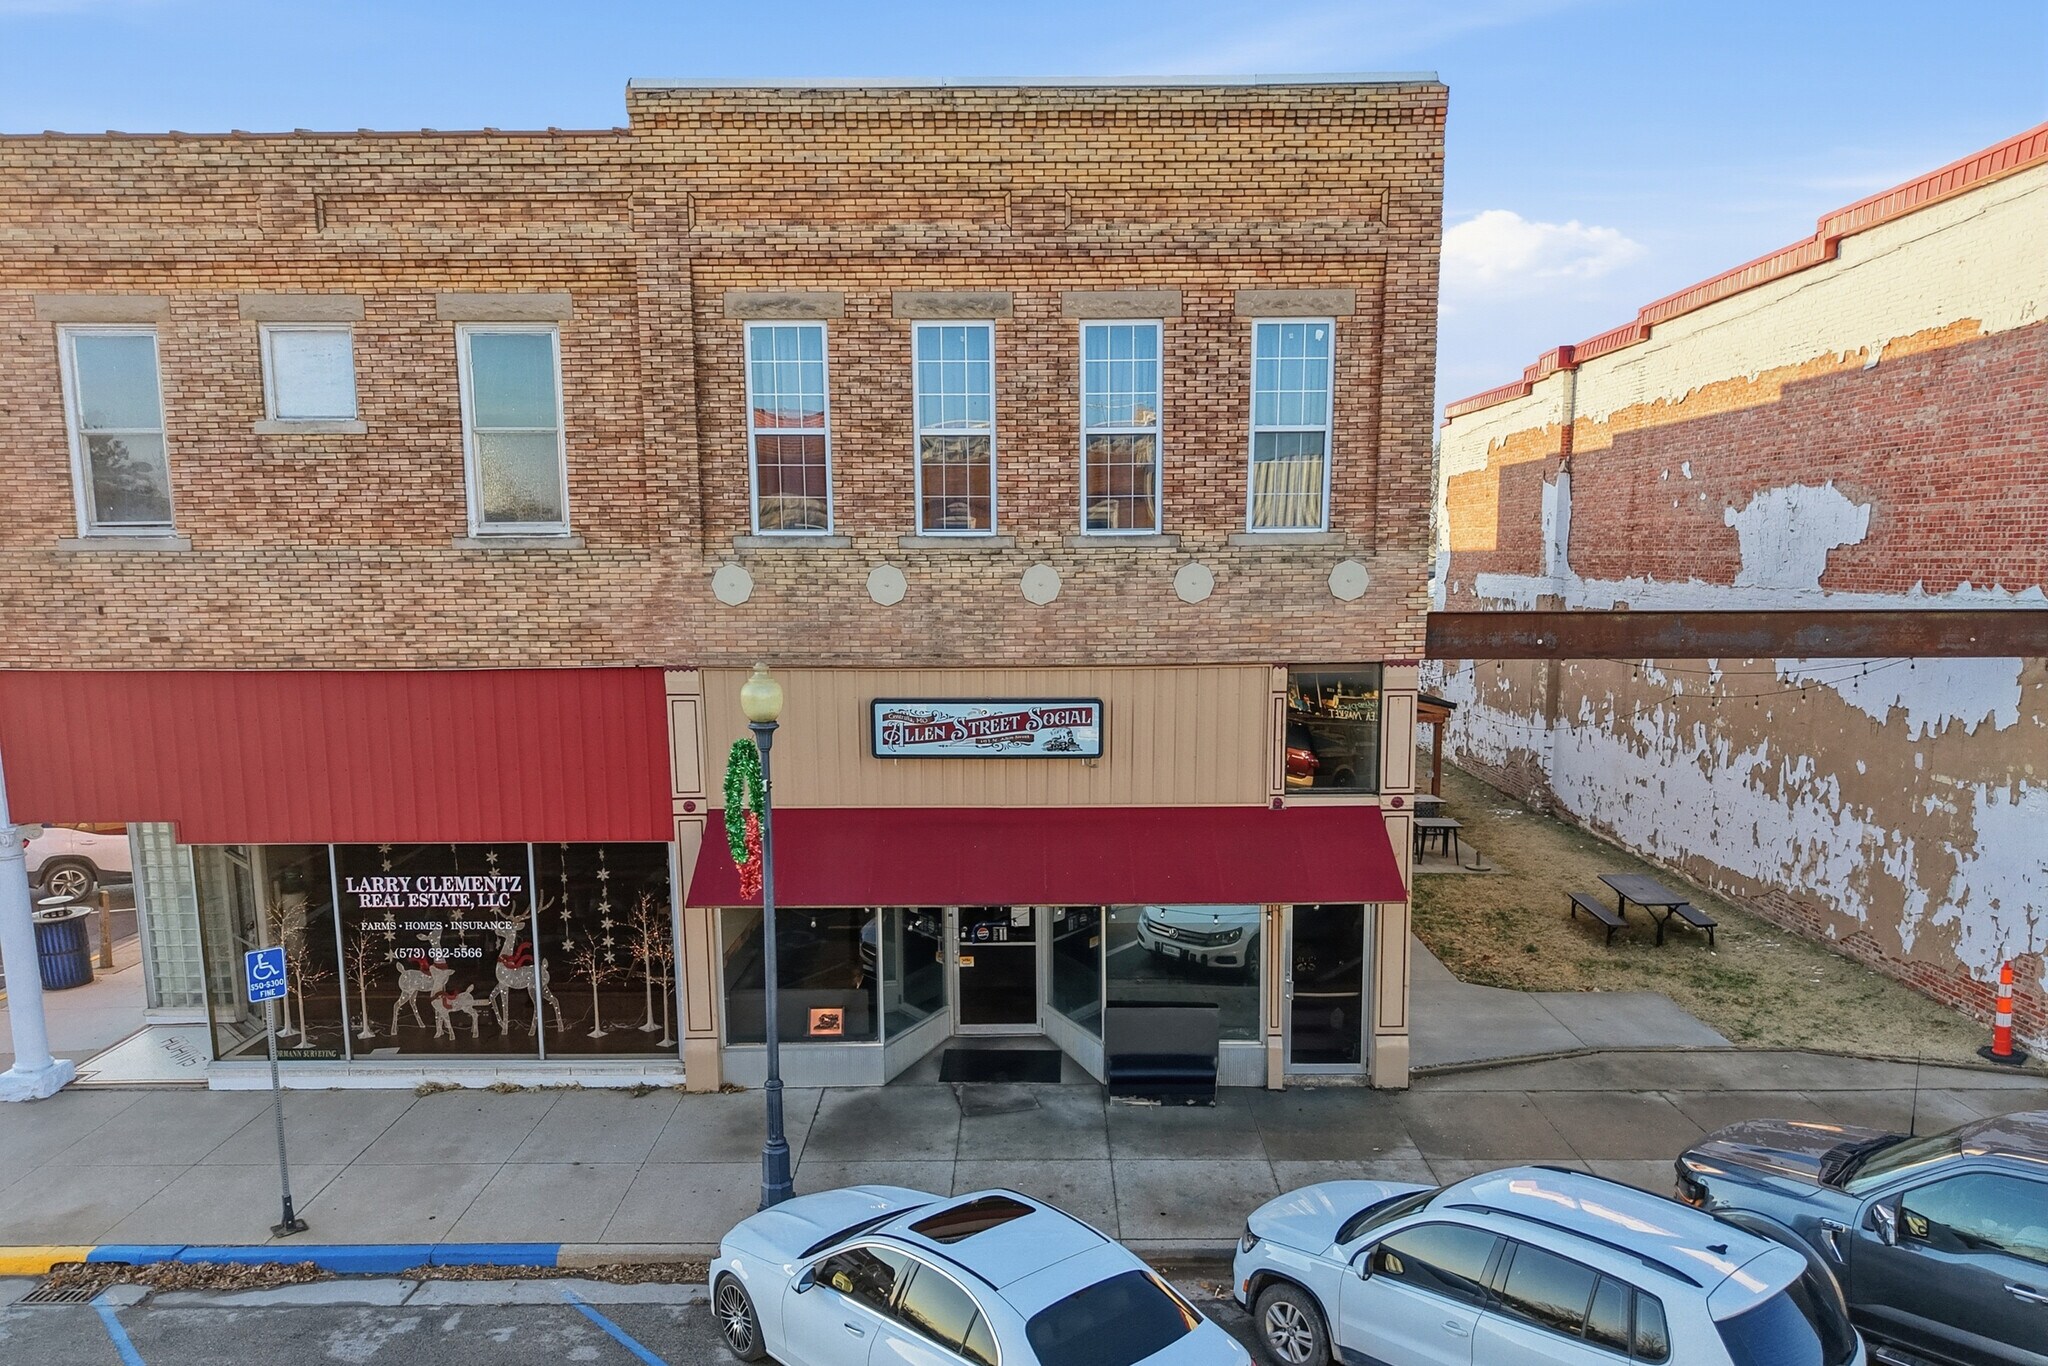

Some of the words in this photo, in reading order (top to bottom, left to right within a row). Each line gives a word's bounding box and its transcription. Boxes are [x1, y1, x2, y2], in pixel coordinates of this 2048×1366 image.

[950, 716, 1021, 743] STREET
[1025, 707, 1092, 731] SOCIAL
[346, 876, 412, 893] LARRY
[416, 875, 522, 893] CLEMENTZ
[359, 893, 405, 908] REAL
[407, 893, 475, 910] ESTATE,
[477, 892, 511, 907] LLC
[361, 922, 397, 931] FARMS
[405, 921, 443, 930] HOMES
[450, 921, 513, 930] INSURANCE
[394, 948, 425, 959] (573)
[428, 947, 482, 959] 682-5566
[250, 978, 284, 991] $50-$300
[260, 988, 276, 998] FINE
[302, 1050, 337, 1058] SURVEYING
